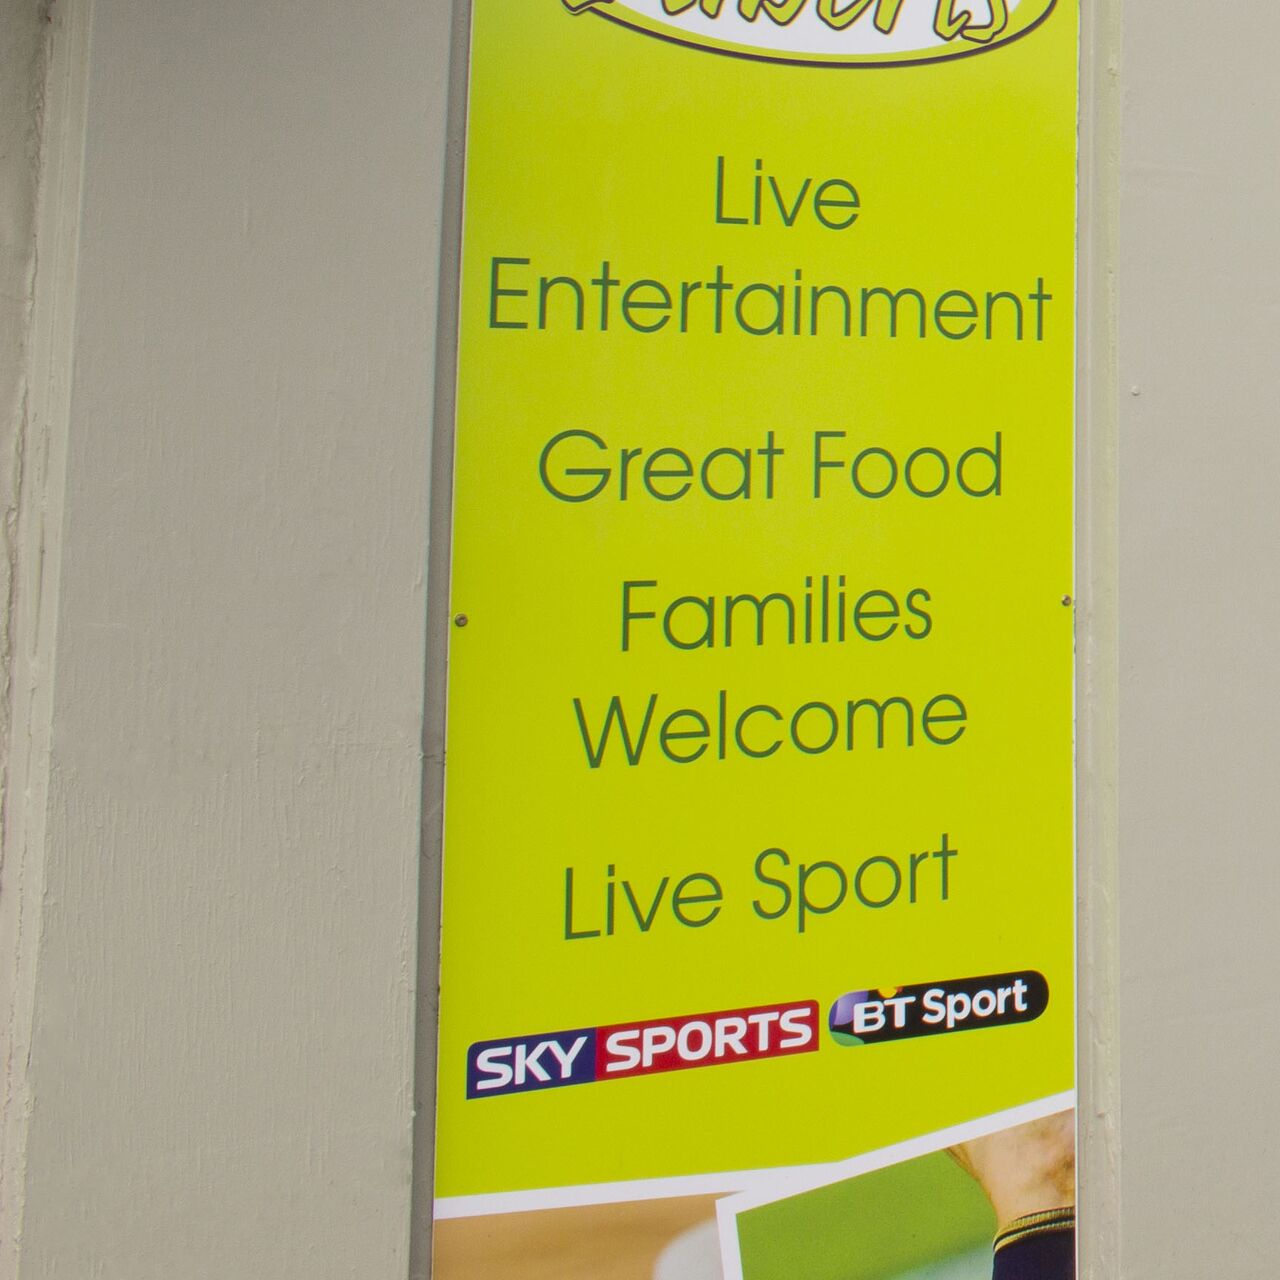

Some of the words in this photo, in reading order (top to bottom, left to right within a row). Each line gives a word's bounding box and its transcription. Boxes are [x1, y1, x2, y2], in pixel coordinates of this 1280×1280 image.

[714, 154, 861, 231] Live
[488, 255, 1053, 341] Entertainment
[538, 428, 786, 503] Great
[813, 430, 1003, 500] Food
[620, 574, 934, 652] Families
[572, 689, 968, 769] Welcome
[562, 863, 723, 941] Live
[751, 832, 959, 933] Sport
[475, 1036, 589, 1091] SKY
[605, 1006, 813, 1074] SPORTS
[851, 995, 916, 1035] BT
[921, 978, 1029, 1028] Sport
